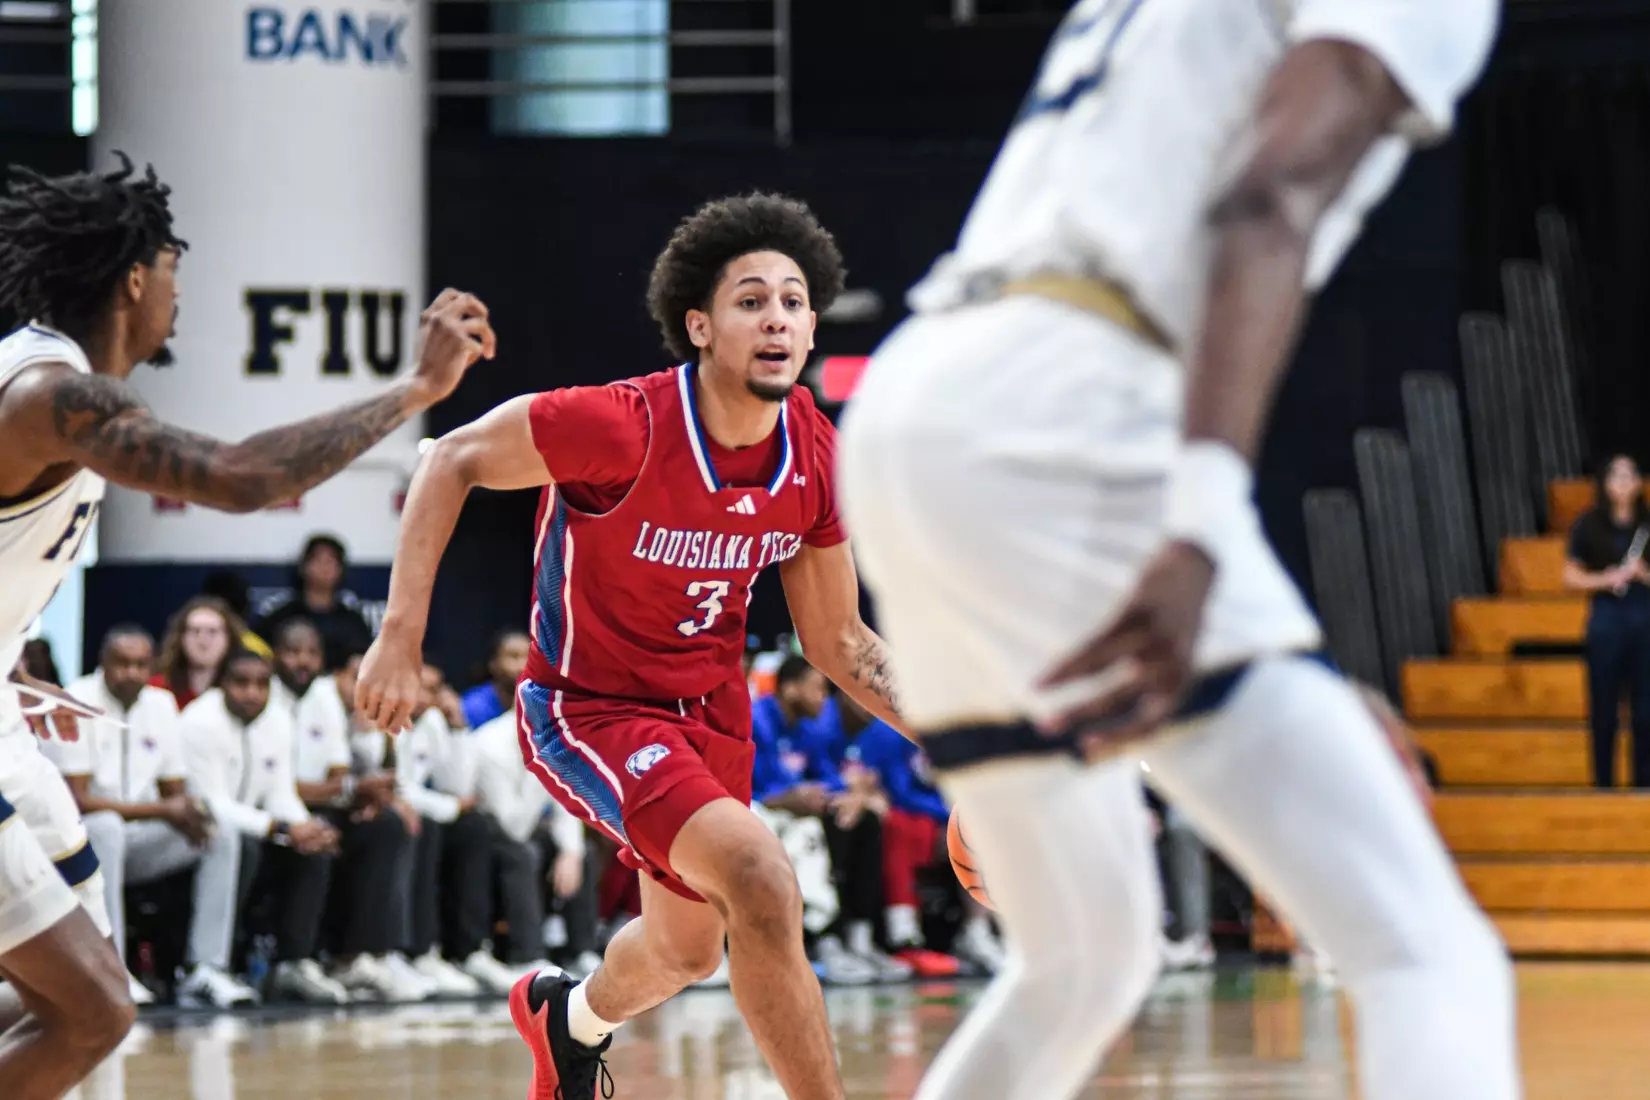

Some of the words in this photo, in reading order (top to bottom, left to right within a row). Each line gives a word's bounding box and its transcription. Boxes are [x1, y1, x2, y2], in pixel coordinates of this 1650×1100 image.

[244, 8, 407, 67] BANK
[243, 289, 405, 376] FIU
[631, 520, 754, 570] LOUISIANA
[676, 580, 731, 637] 3
